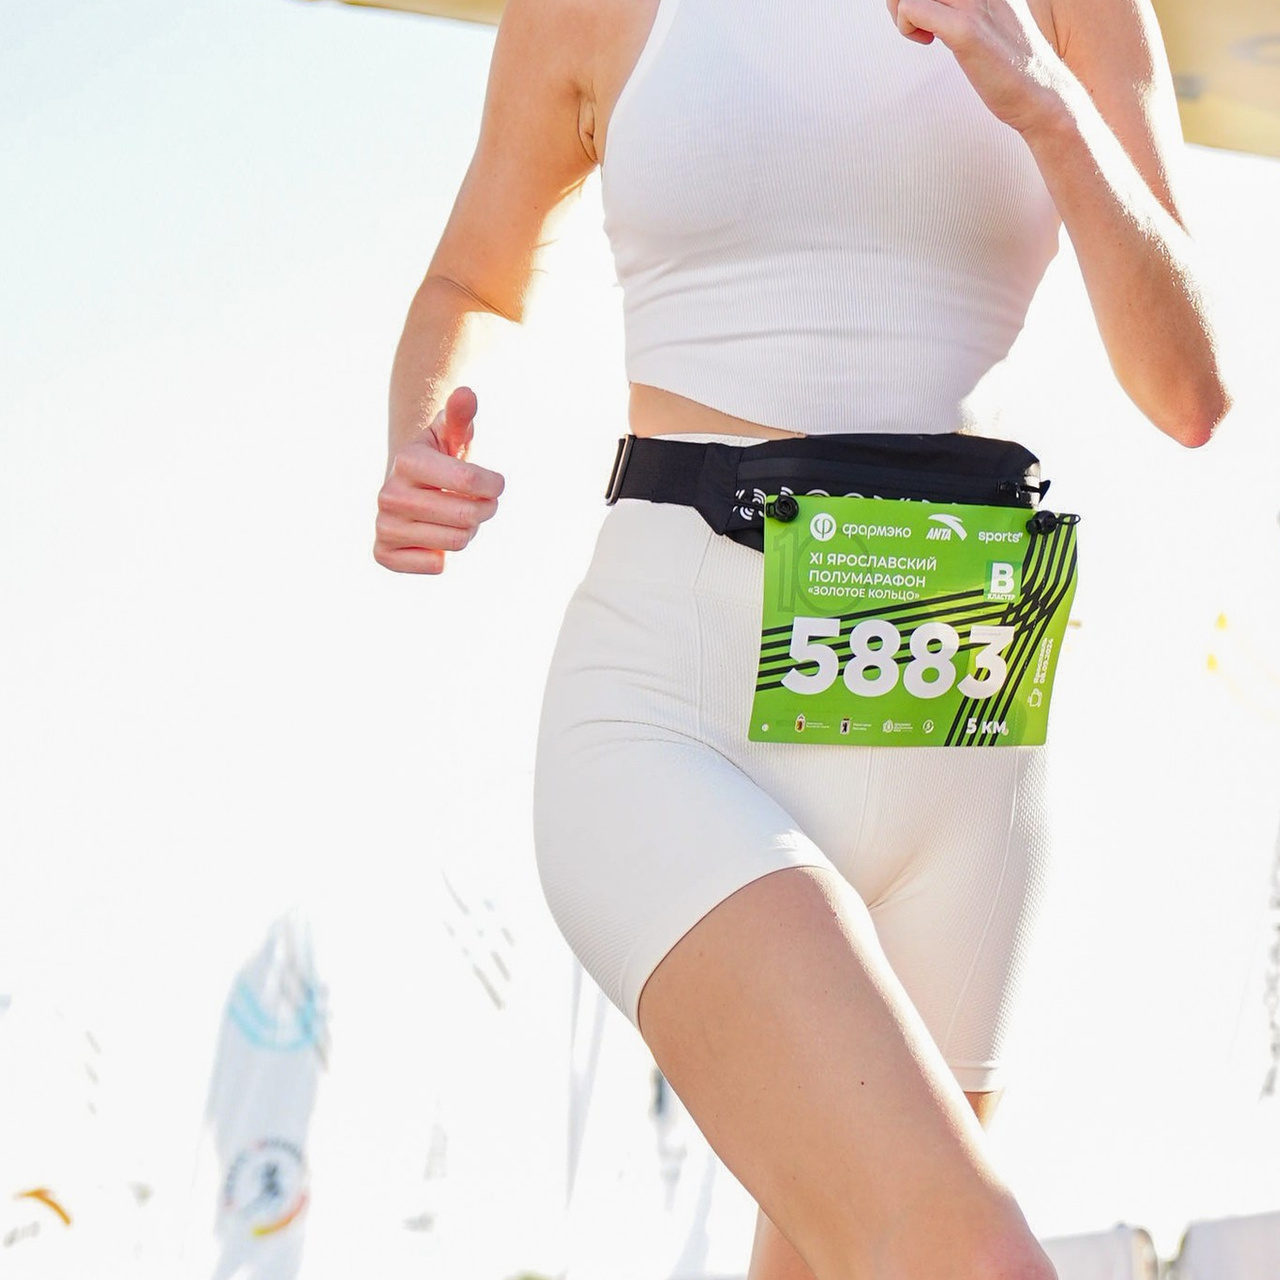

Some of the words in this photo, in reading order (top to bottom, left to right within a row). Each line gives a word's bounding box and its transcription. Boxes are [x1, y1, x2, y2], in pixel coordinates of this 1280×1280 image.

[842, 523, 912, 540] фармэко
[926, 527, 952, 541] ANTA
[809, 552, 823, 565] XI
[827, 552, 937, 571] ЯРОСЛАВСКИЙ
[809, 570, 926, 588] ПОЛУМАРАФОН
[808, 586, 865, 598] «ЗОЛОТОЕ
[868, 590, 920, 601] КОЛЬЦО»
[781, 616, 1015, 699] 5883
[966, 717, 977, 734] 5
